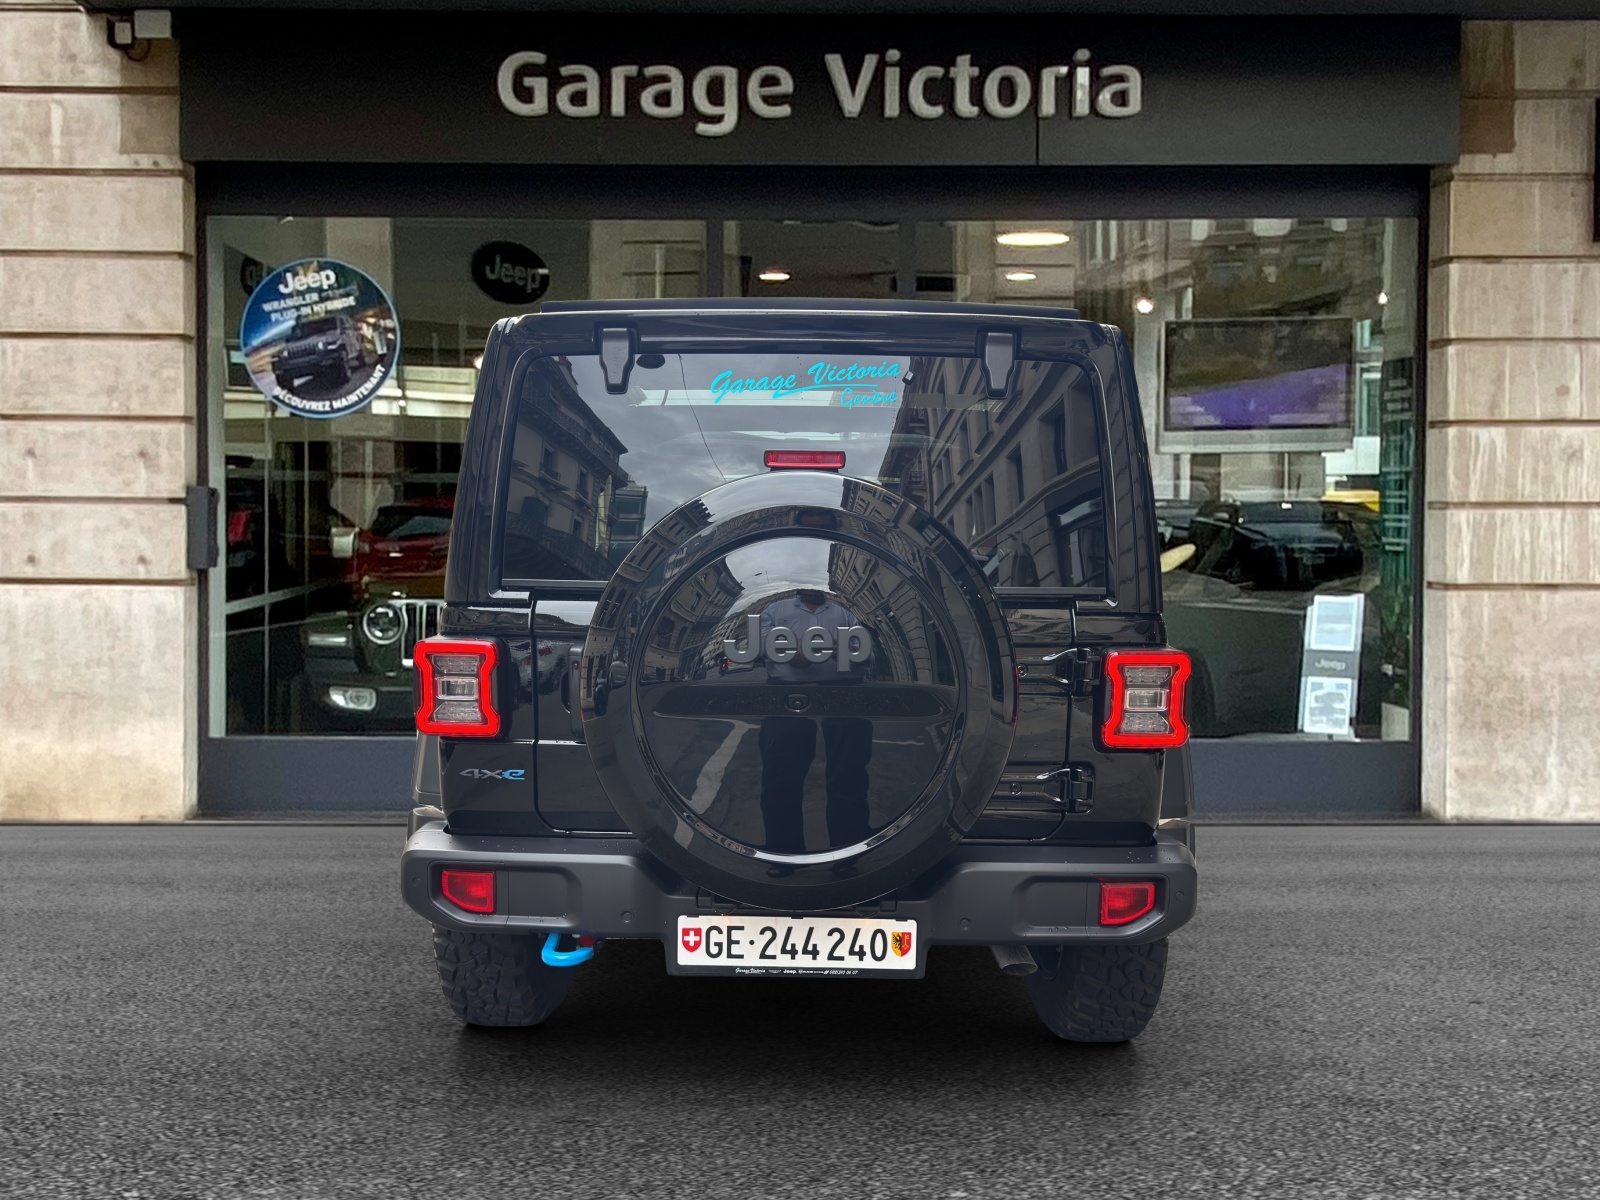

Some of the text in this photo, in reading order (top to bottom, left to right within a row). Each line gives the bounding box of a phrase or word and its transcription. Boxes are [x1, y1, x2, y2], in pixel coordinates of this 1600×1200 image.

[497, 48, 1143, 136] Garage Victoria
[278, 269, 337, 294] Jeep
[485, 253, 543, 293] Jeep
[262, 292, 320, 312] WRANGLER
[332, 363, 386, 410] MAINTENANT
[710, 361, 901, 404] Garage Victoria
[841, 388, 898, 409] Genève
[722, 614, 874, 673] Jeep
[1315, 658, 1347, 671] Jeep
